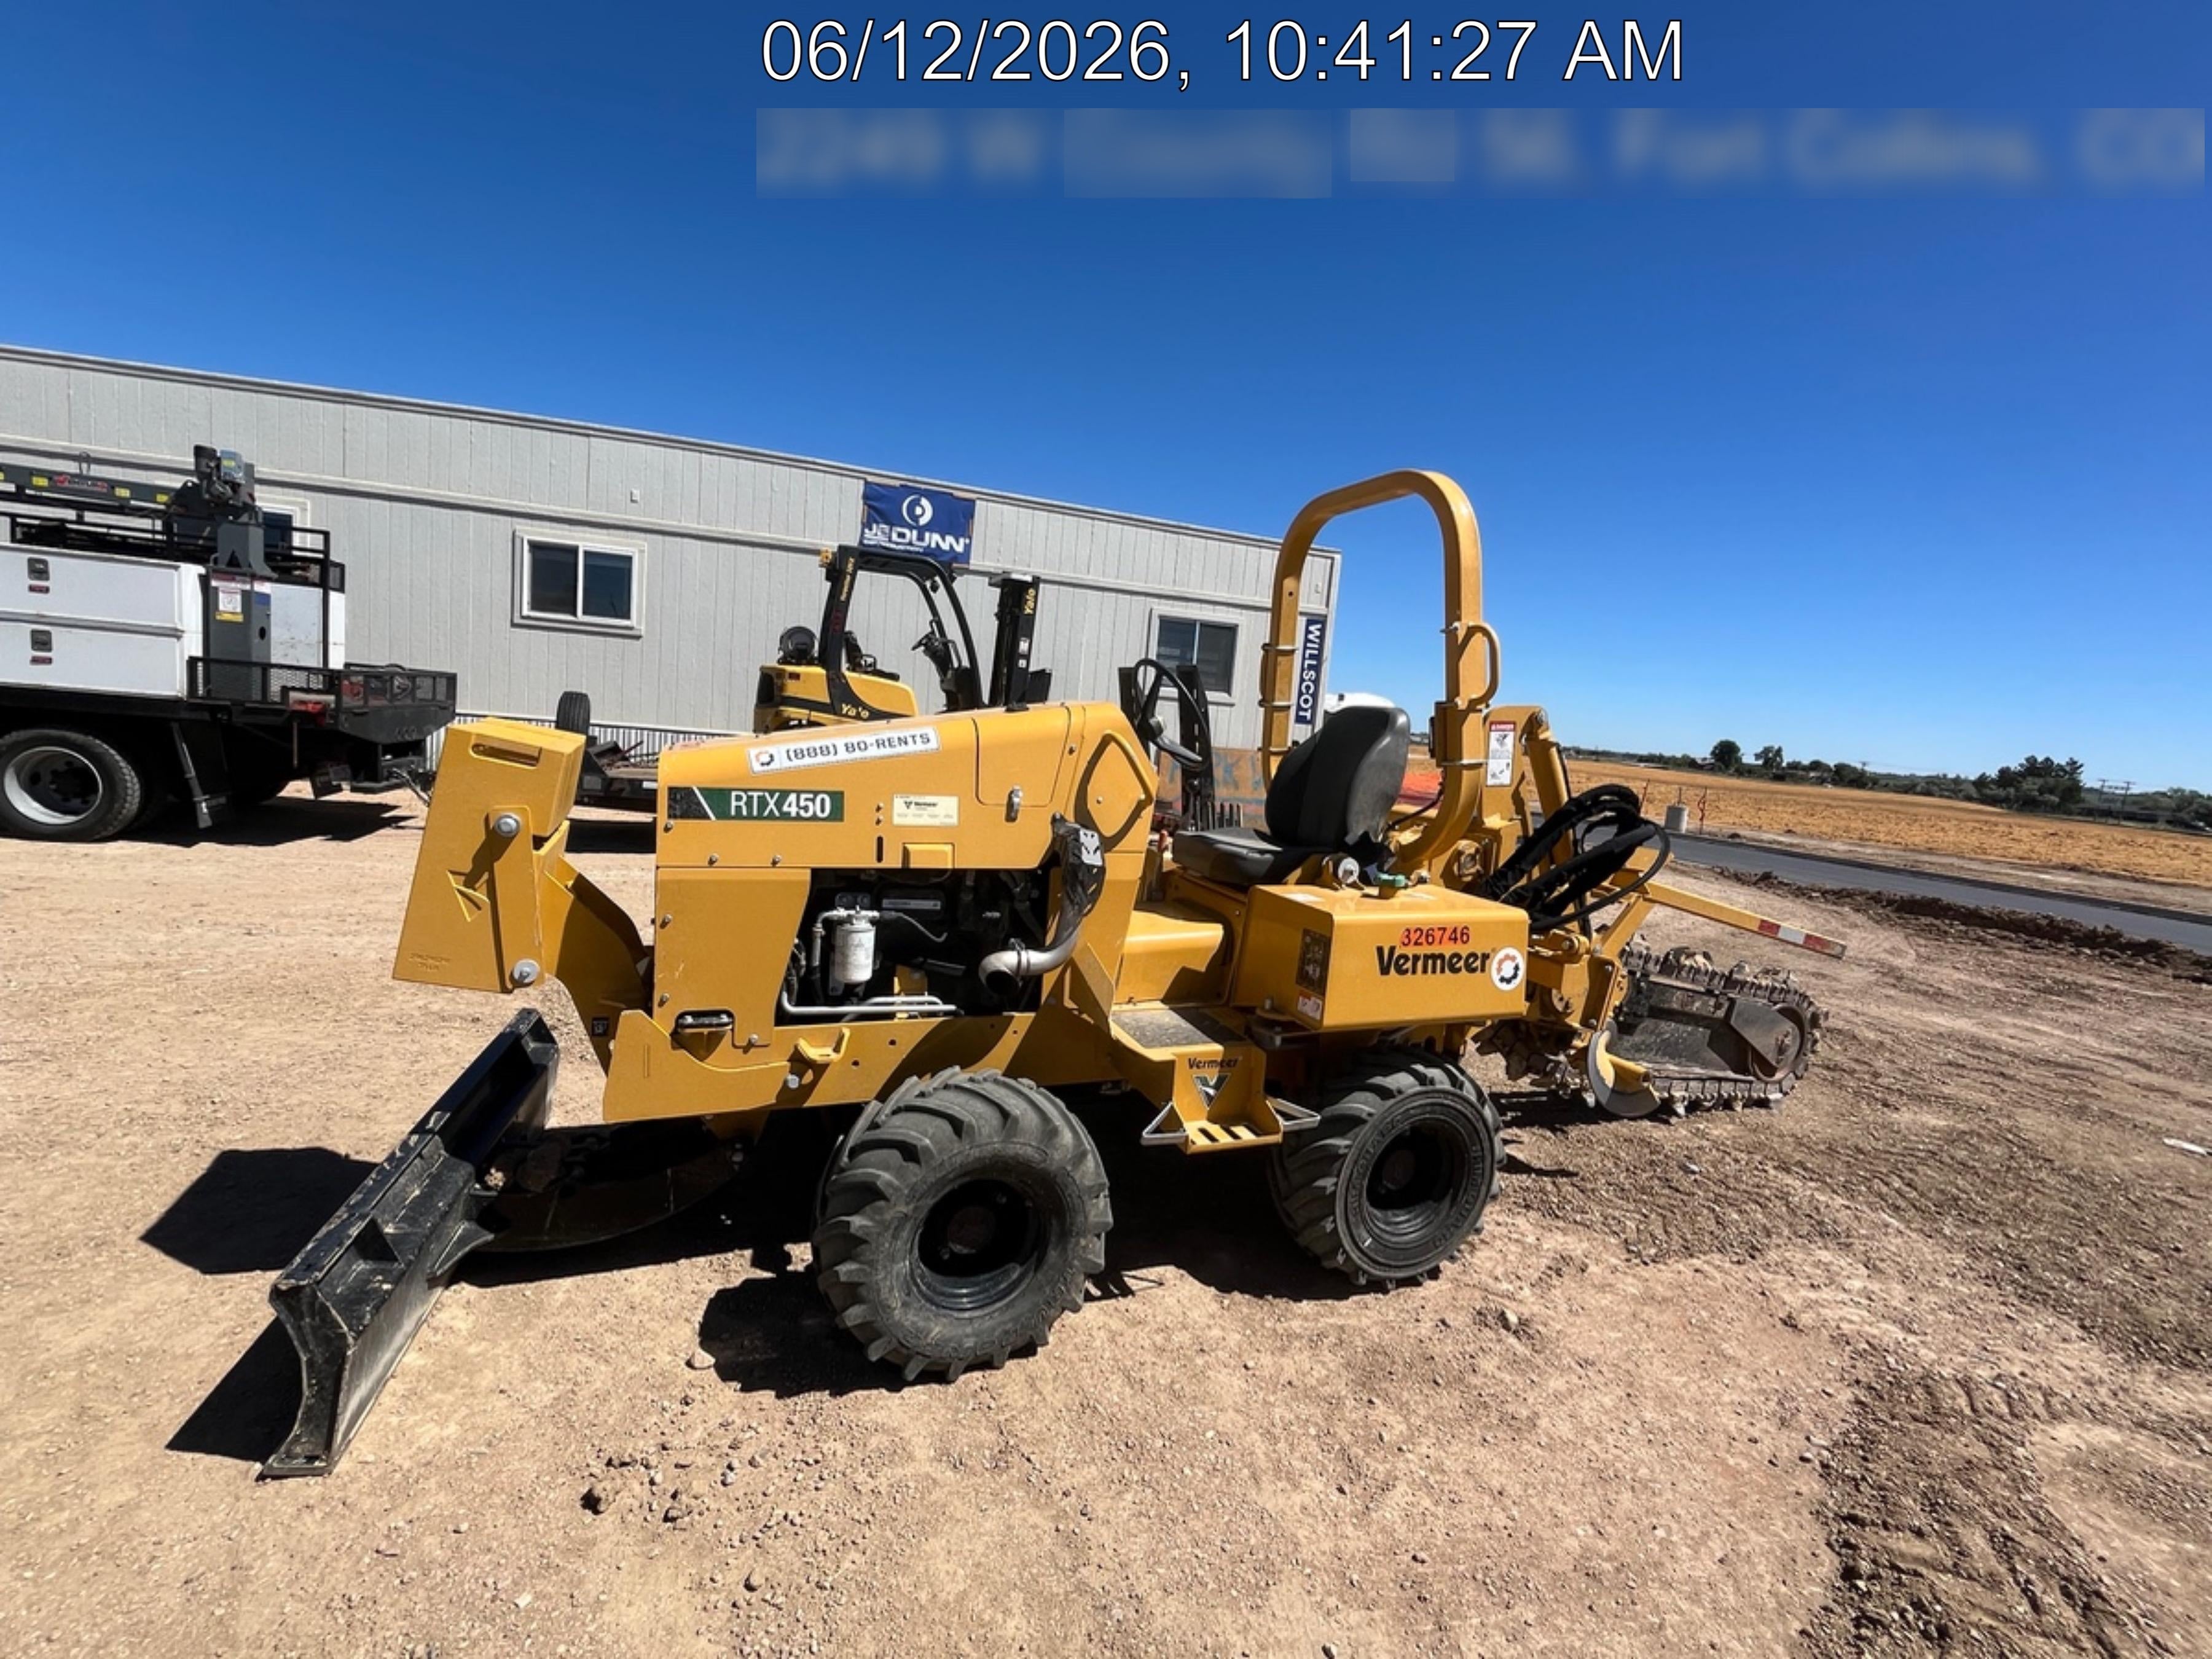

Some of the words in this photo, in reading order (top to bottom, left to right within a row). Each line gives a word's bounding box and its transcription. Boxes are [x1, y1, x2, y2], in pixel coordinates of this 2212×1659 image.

[1298, 624, 1322, 721] WILLSCOT
[786, 743, 838, 762] (888)
[731, 791, 831, 818] RTX450
[1401, 925, 1470, 946] 326746
[1376, 945, 1490, 976] Vermeer
